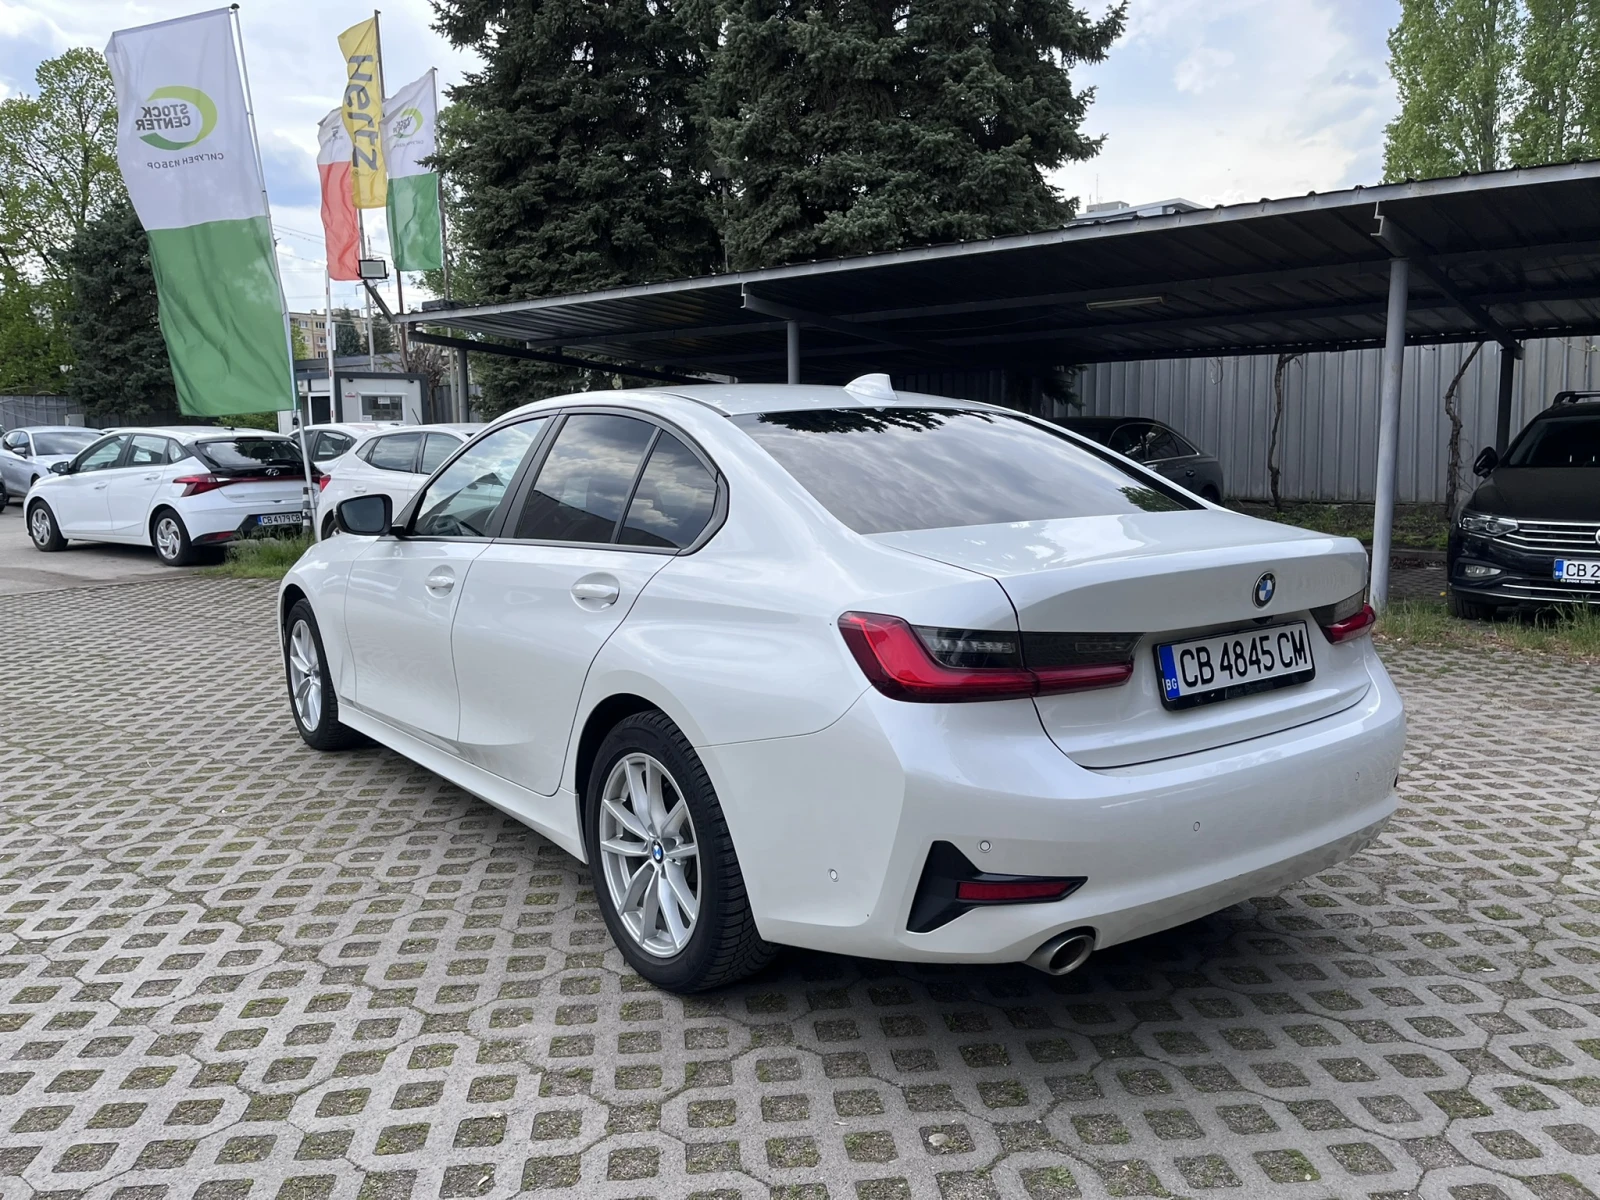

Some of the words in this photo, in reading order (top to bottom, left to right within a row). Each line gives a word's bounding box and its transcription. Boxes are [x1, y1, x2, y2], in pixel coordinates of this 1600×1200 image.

[344, 54, 379, 171] Hertz
[274, 515, 291, 524] 4179
[1566, 563, 1587, 577] CB
[1179, 646, 1215, 688] CB
[1219, 634, 1276, 680] 4845
[1276, 629, 1308, 669] CM
[1165, 678, 1178, 691] BG
